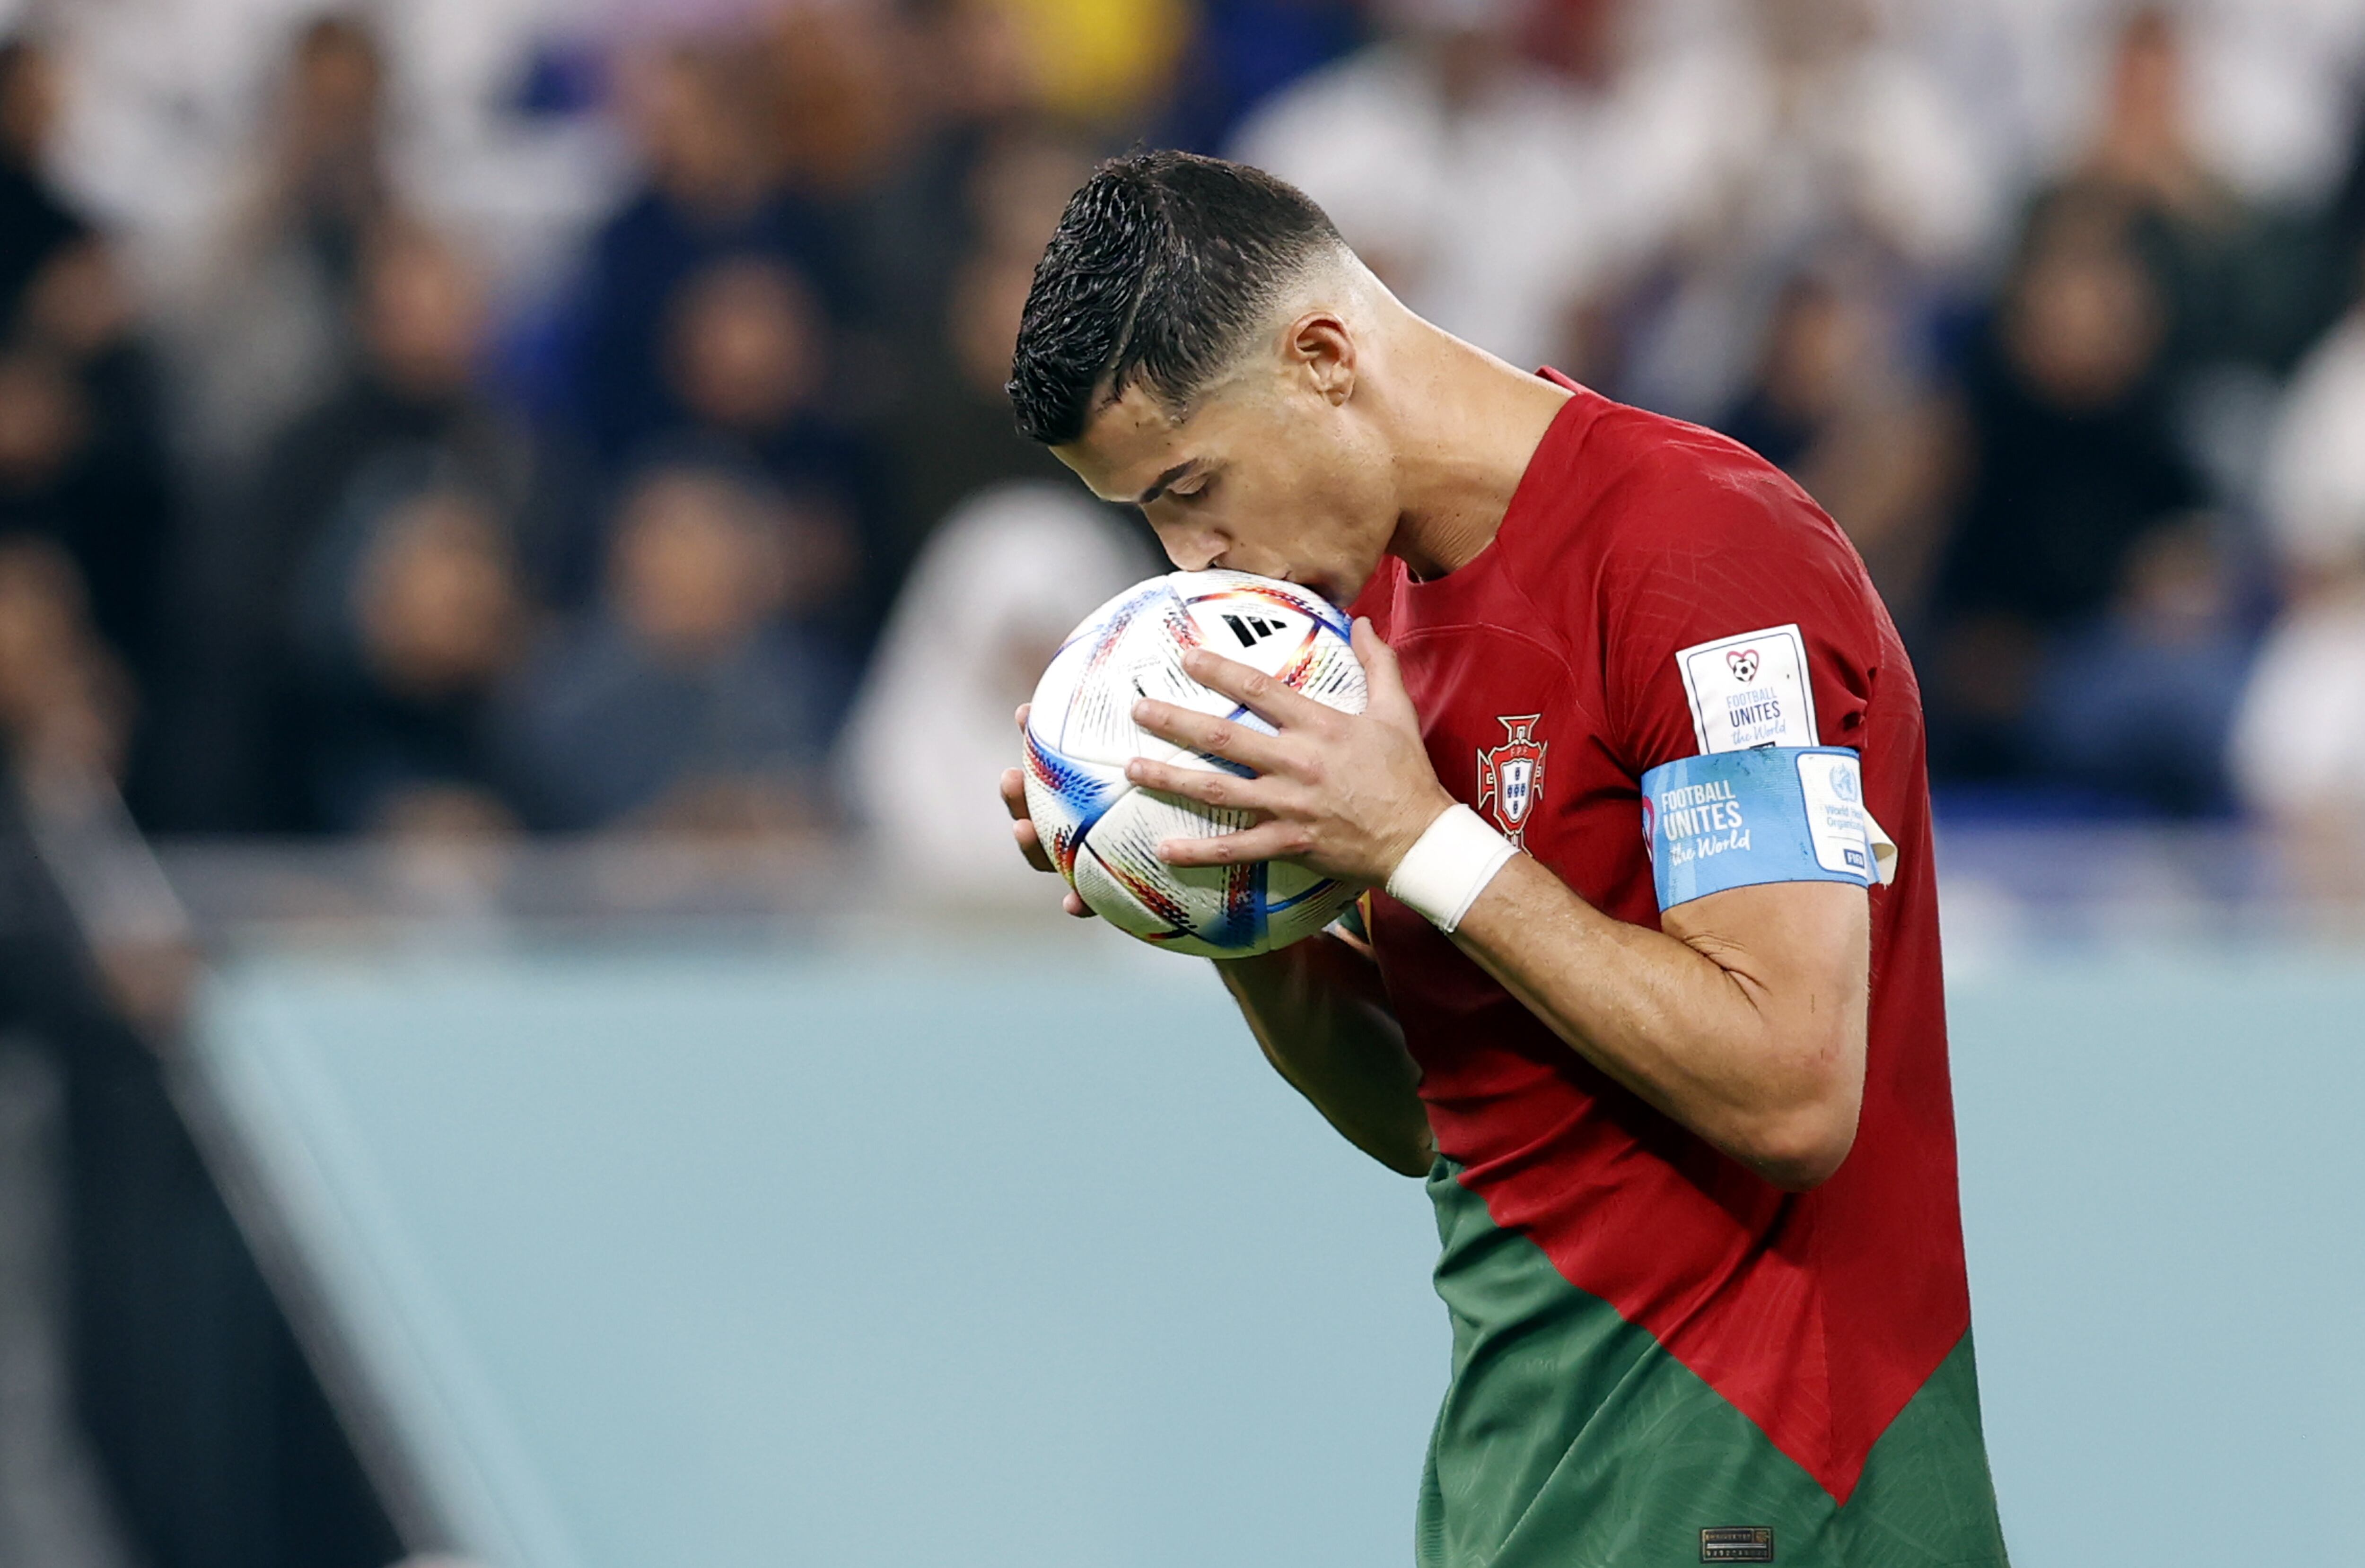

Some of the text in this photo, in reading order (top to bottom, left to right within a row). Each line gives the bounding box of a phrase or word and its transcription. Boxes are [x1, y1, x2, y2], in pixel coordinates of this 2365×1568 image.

[1726, 687, 1777, 708] FOOTBALL
[1730, 700, 1780, 727] UNITES
[1731, 718, 1786, 745] the World
[1661, 780, 1736, 813] FOOTBALL
[1663, 801, 1743, 841] UNITES
[1670, 828, 1751, 866] the World
